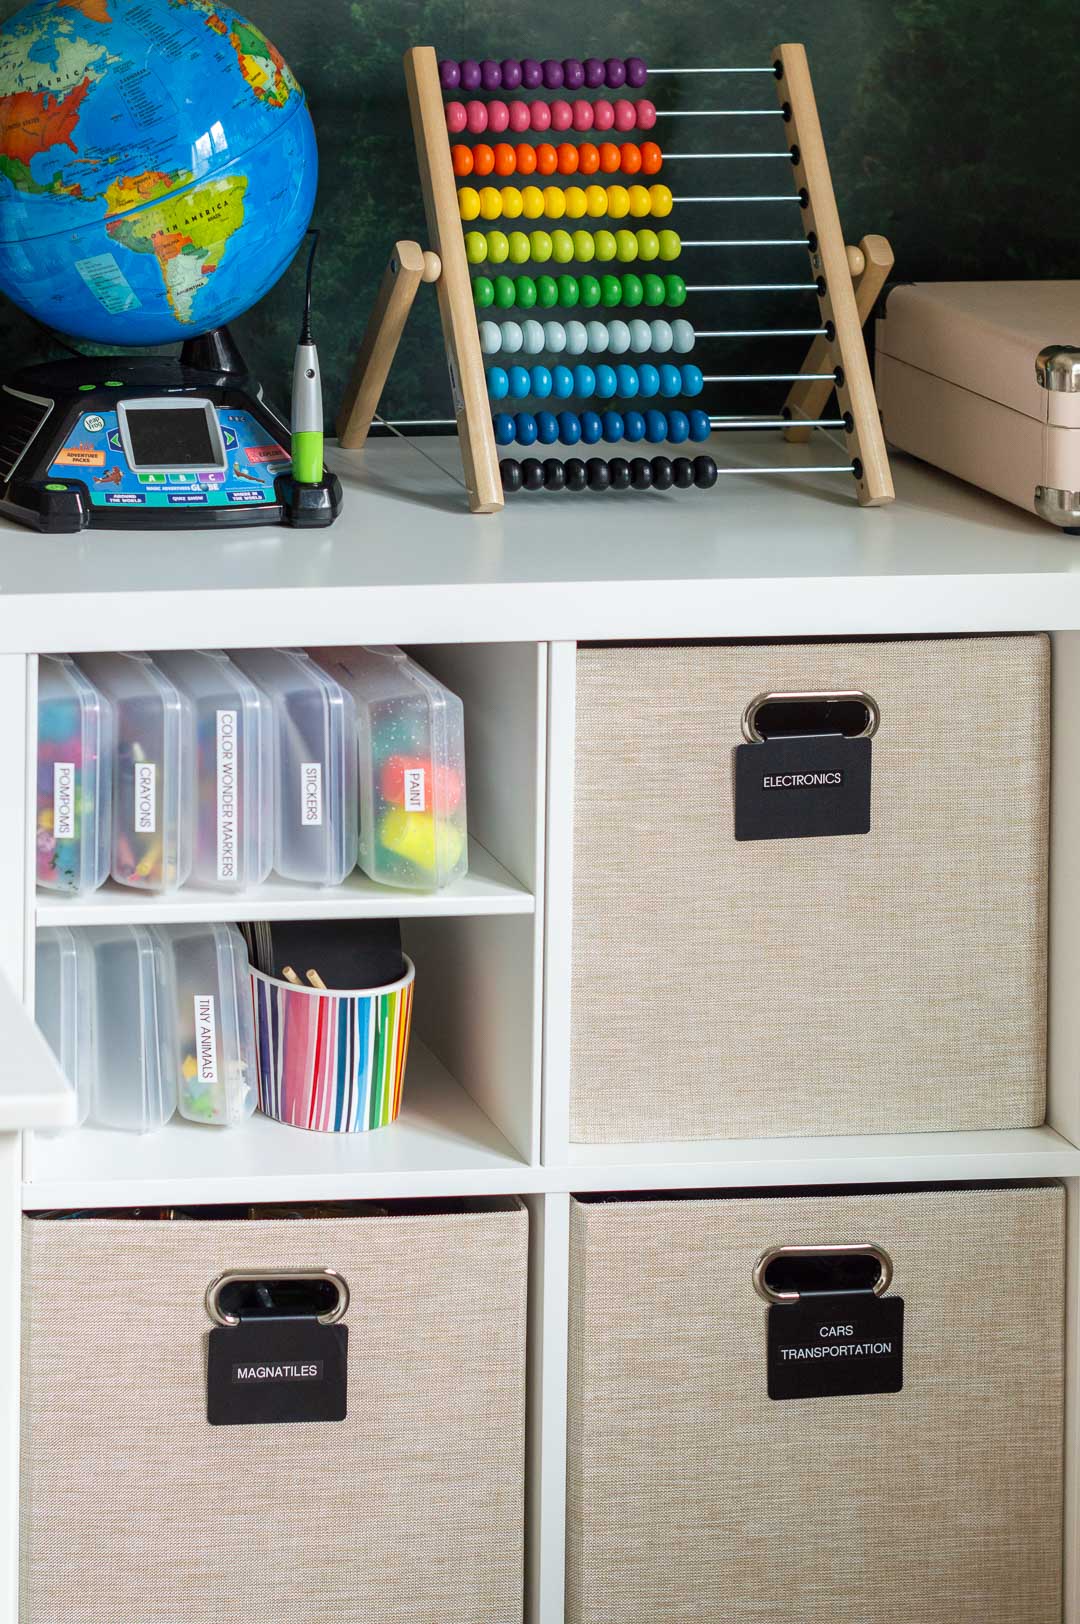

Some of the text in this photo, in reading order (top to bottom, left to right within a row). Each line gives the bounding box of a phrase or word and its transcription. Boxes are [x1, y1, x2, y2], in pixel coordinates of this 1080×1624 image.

[144, 200, 229, 242] SOUTH AMERICA
[59, 768, 71, 833] POMPOMS
[140, 767, 152, 828] CRAYONS
[221, 714, 234, 877] COLOR WONDER MARKERS
[306, 768, 318, 820] STICKERS
[409, 773, 421, 806] PAINT
[763, 772, 842, 788] ELECTRONICS
[199, 999, 214, 1079] TINY ANIMALS
[780, 1342, 892, 1360] TRANSPORTATION
[819, 1325, 854, 1338] CARS
[237, 1364, 318, 1380] MAGNATILES
